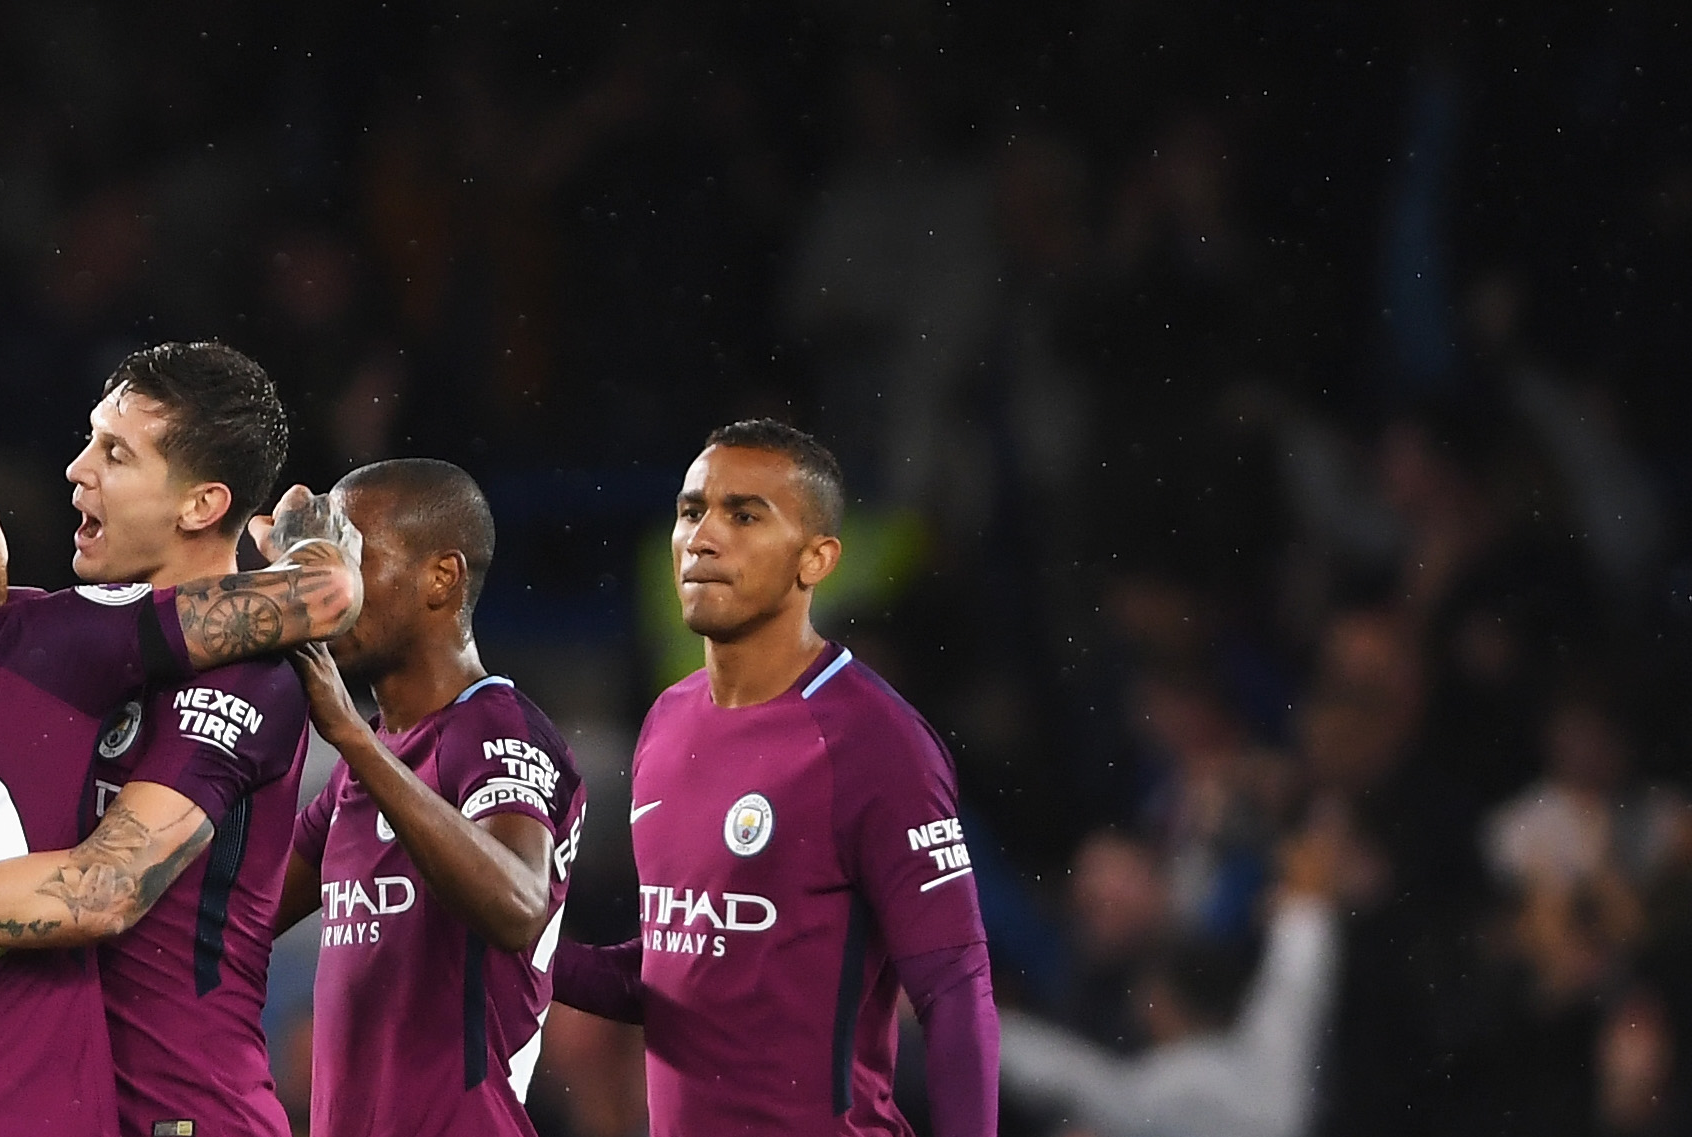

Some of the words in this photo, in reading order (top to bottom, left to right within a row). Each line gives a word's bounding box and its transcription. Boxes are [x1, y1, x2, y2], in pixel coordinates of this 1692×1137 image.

[173, 688, 263, 735] NEXEN
[179, 709, 242, 750] TIRE
[482, 738, 561, 784] NEXE
[907, 817, 964, 851] NEXE
[929, 843, 971, 871] TIR
[321, 876, 416, 920] TIHAD
[639, 884, 777, 931] TIHAD
[321, 921, 380, 948] IRWAYS
